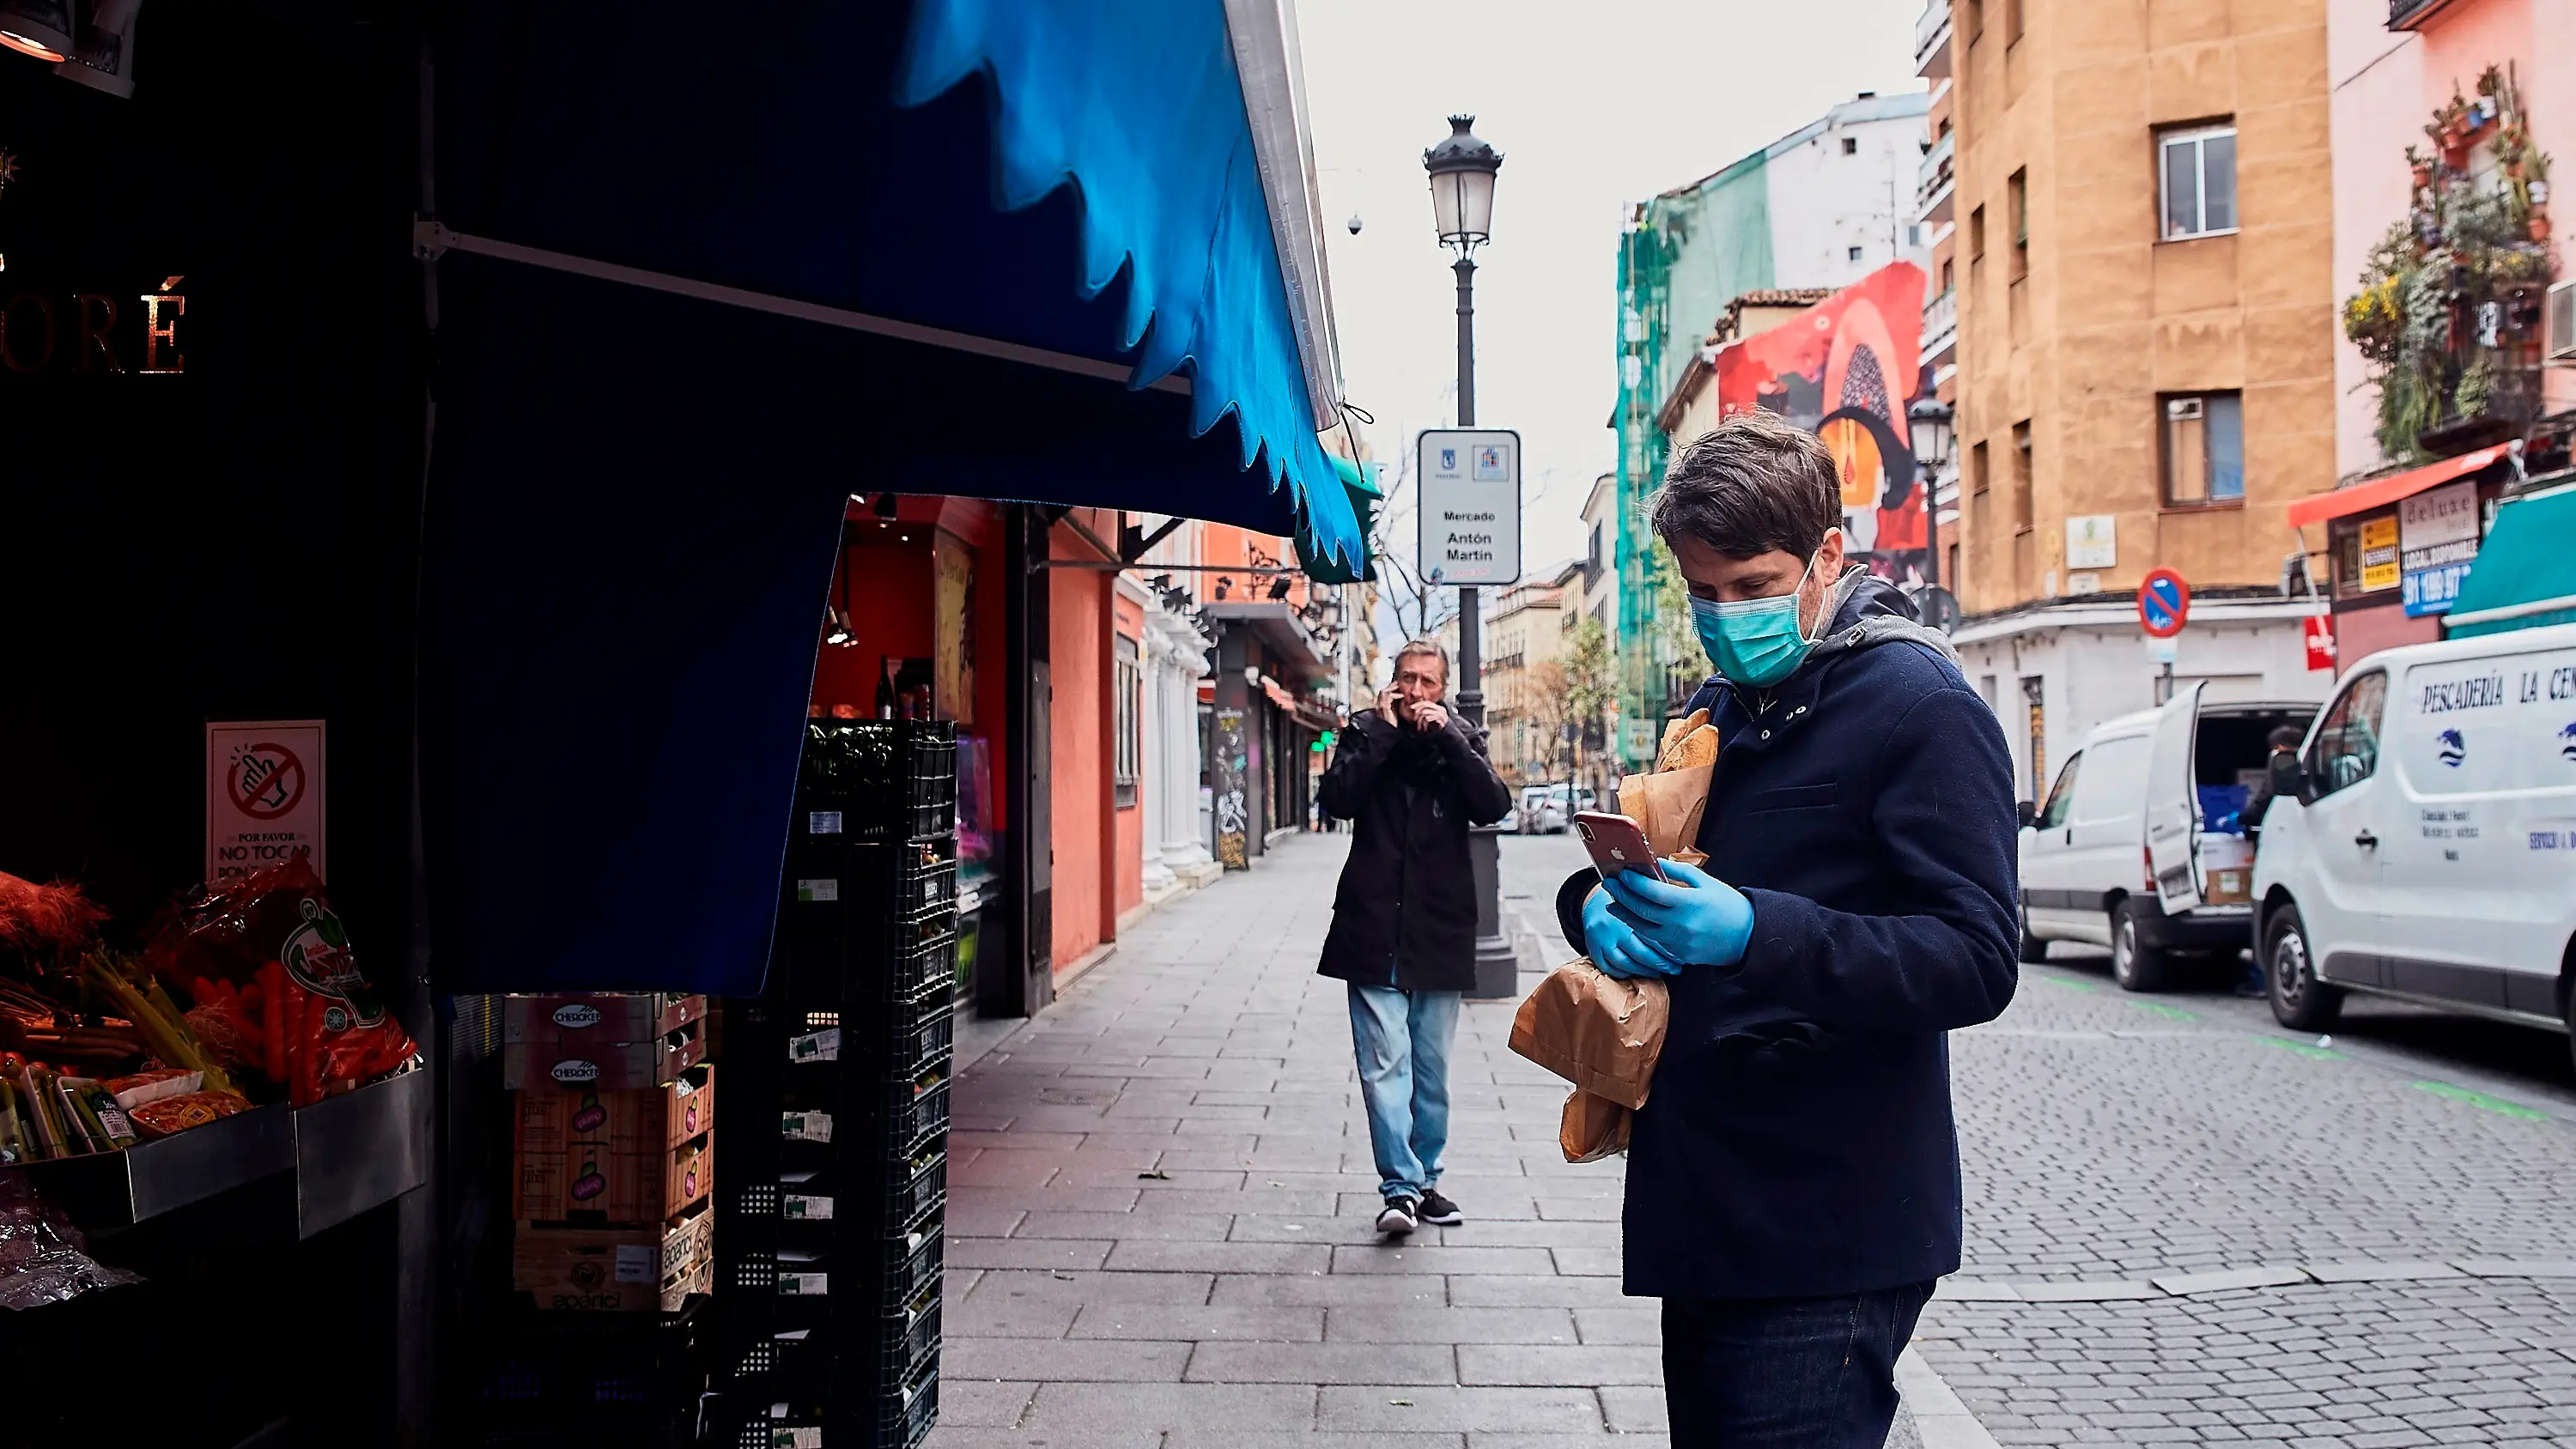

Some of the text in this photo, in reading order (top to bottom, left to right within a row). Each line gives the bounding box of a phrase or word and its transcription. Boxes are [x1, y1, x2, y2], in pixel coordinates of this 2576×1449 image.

[1444, 512, 1495, 522] Mercado
[1448, 532, 1492, 544] Antón
[1447, 549, 1492, 561] Martín
[2422, 669, 2503, 713] PESCADERÍA
[2520, 671, 2538, 703] LA
[239, 833, 295, 842] POR FAVOR
[220, 845, 311, 860] NO TOCAR
[218, 864, 258, 878] DON'
[555, 1013, 600, 1022] CHEROKEE
[665, 1236, 691, 1270] aparici
[553, 1292, 621, 1309] aparici
